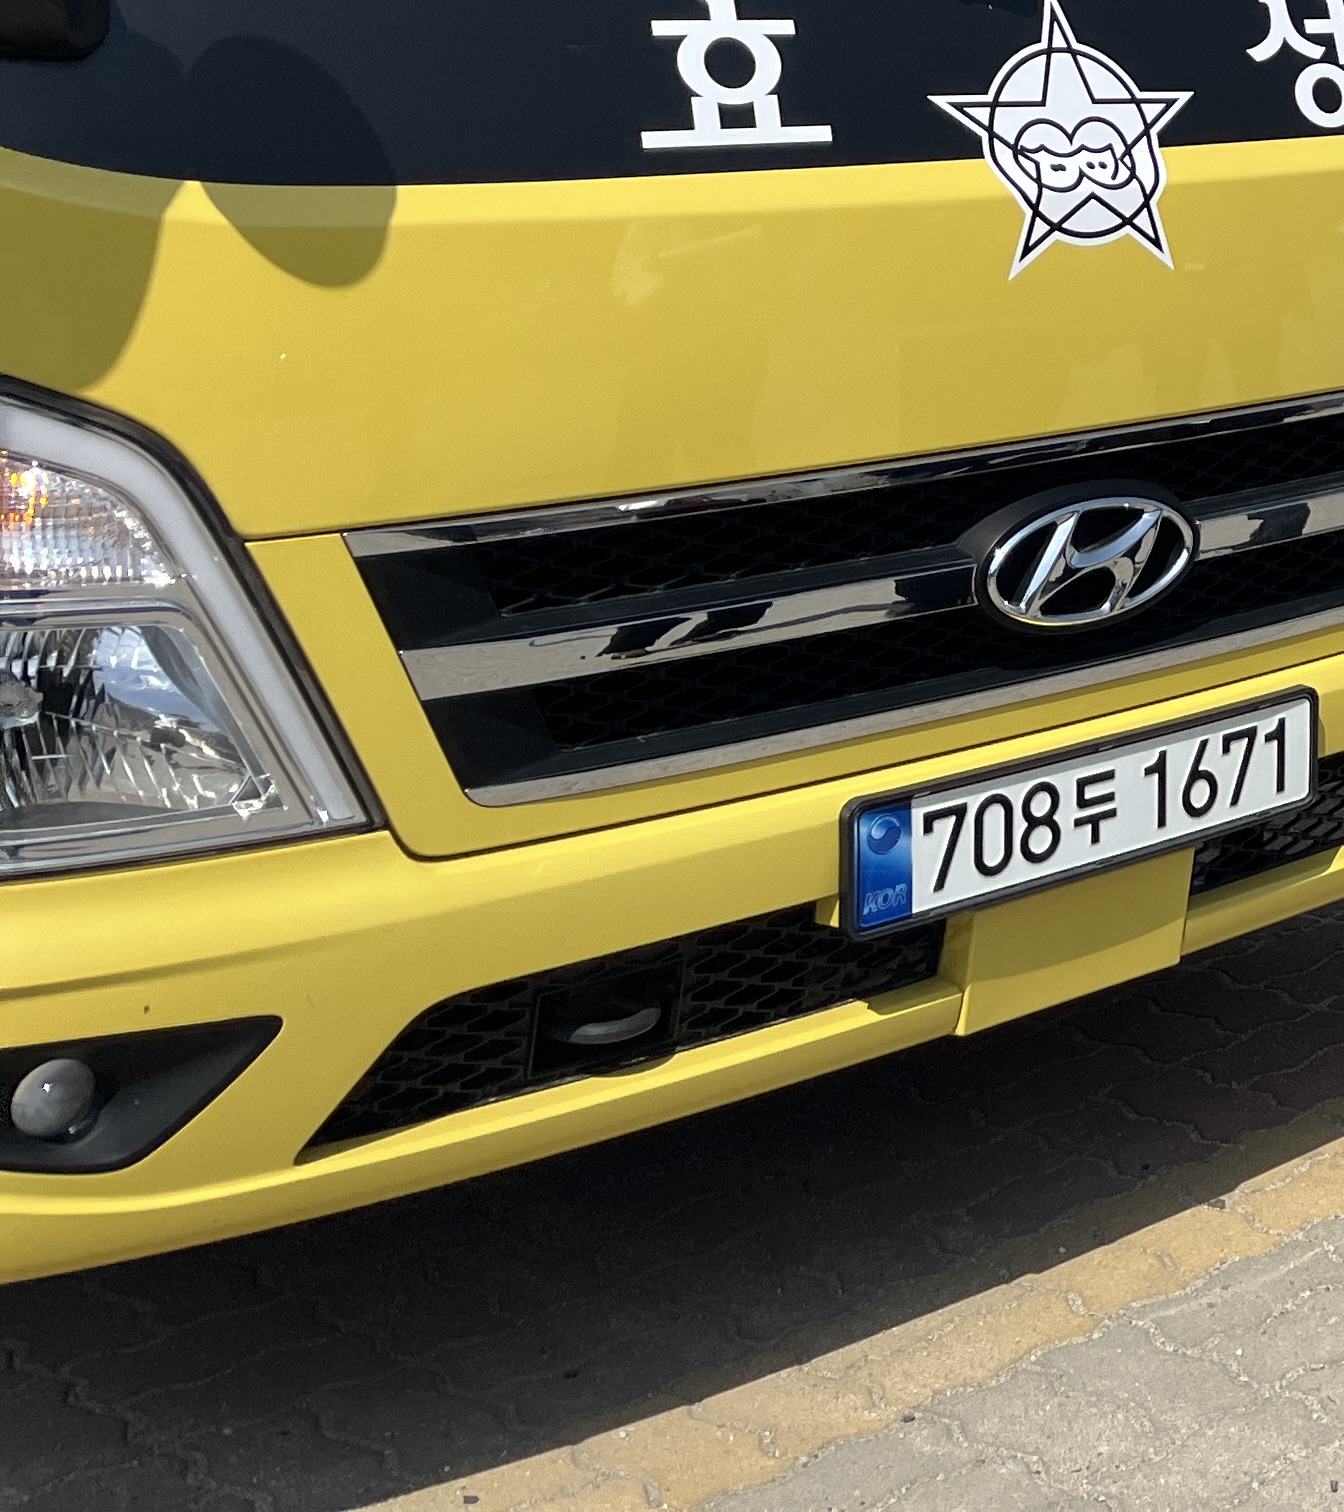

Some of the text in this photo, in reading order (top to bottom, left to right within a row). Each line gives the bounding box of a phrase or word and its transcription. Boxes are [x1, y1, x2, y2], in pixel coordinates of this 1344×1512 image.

[922, 716, 1287, 894] 708두 1671
[863, 883, 908, 915] KOR
